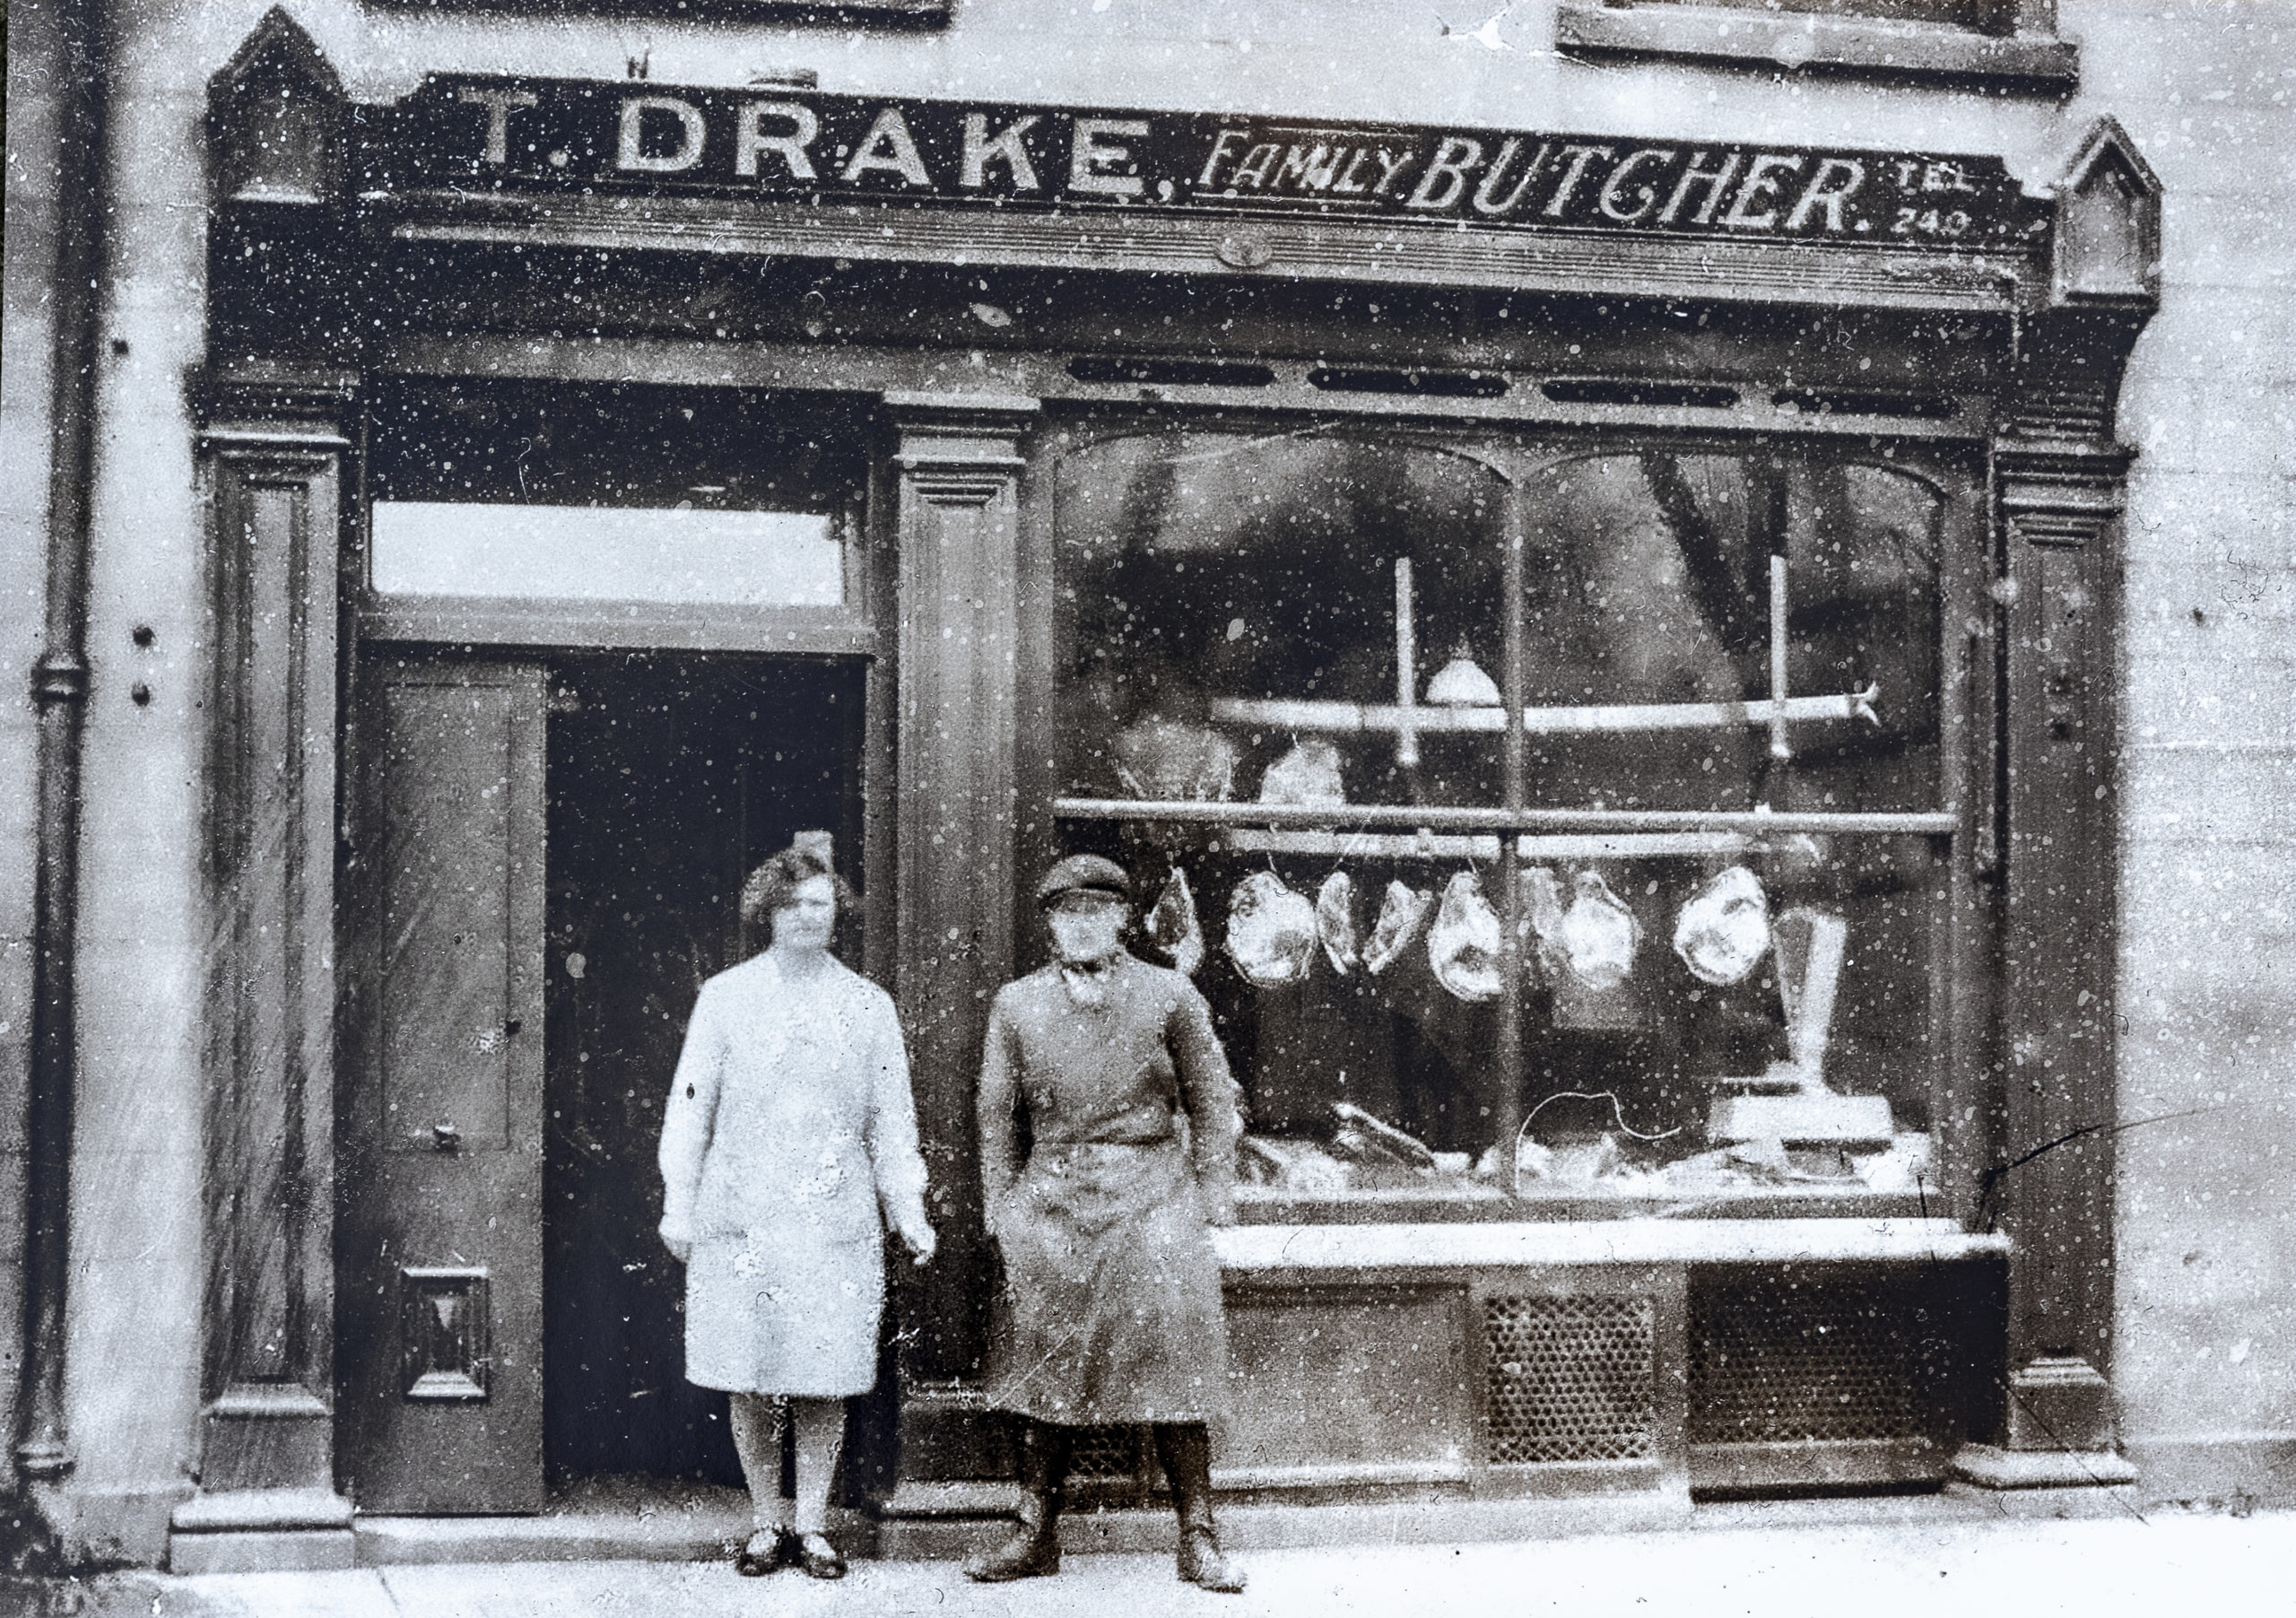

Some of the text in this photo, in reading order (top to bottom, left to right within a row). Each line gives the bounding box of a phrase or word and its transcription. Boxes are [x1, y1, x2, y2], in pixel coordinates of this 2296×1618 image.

[459, 86, 569, 169] T.
[1197, 129, 1415, 194] FAMILY
[1407, 137, 1871, 231] BUTCHER.
